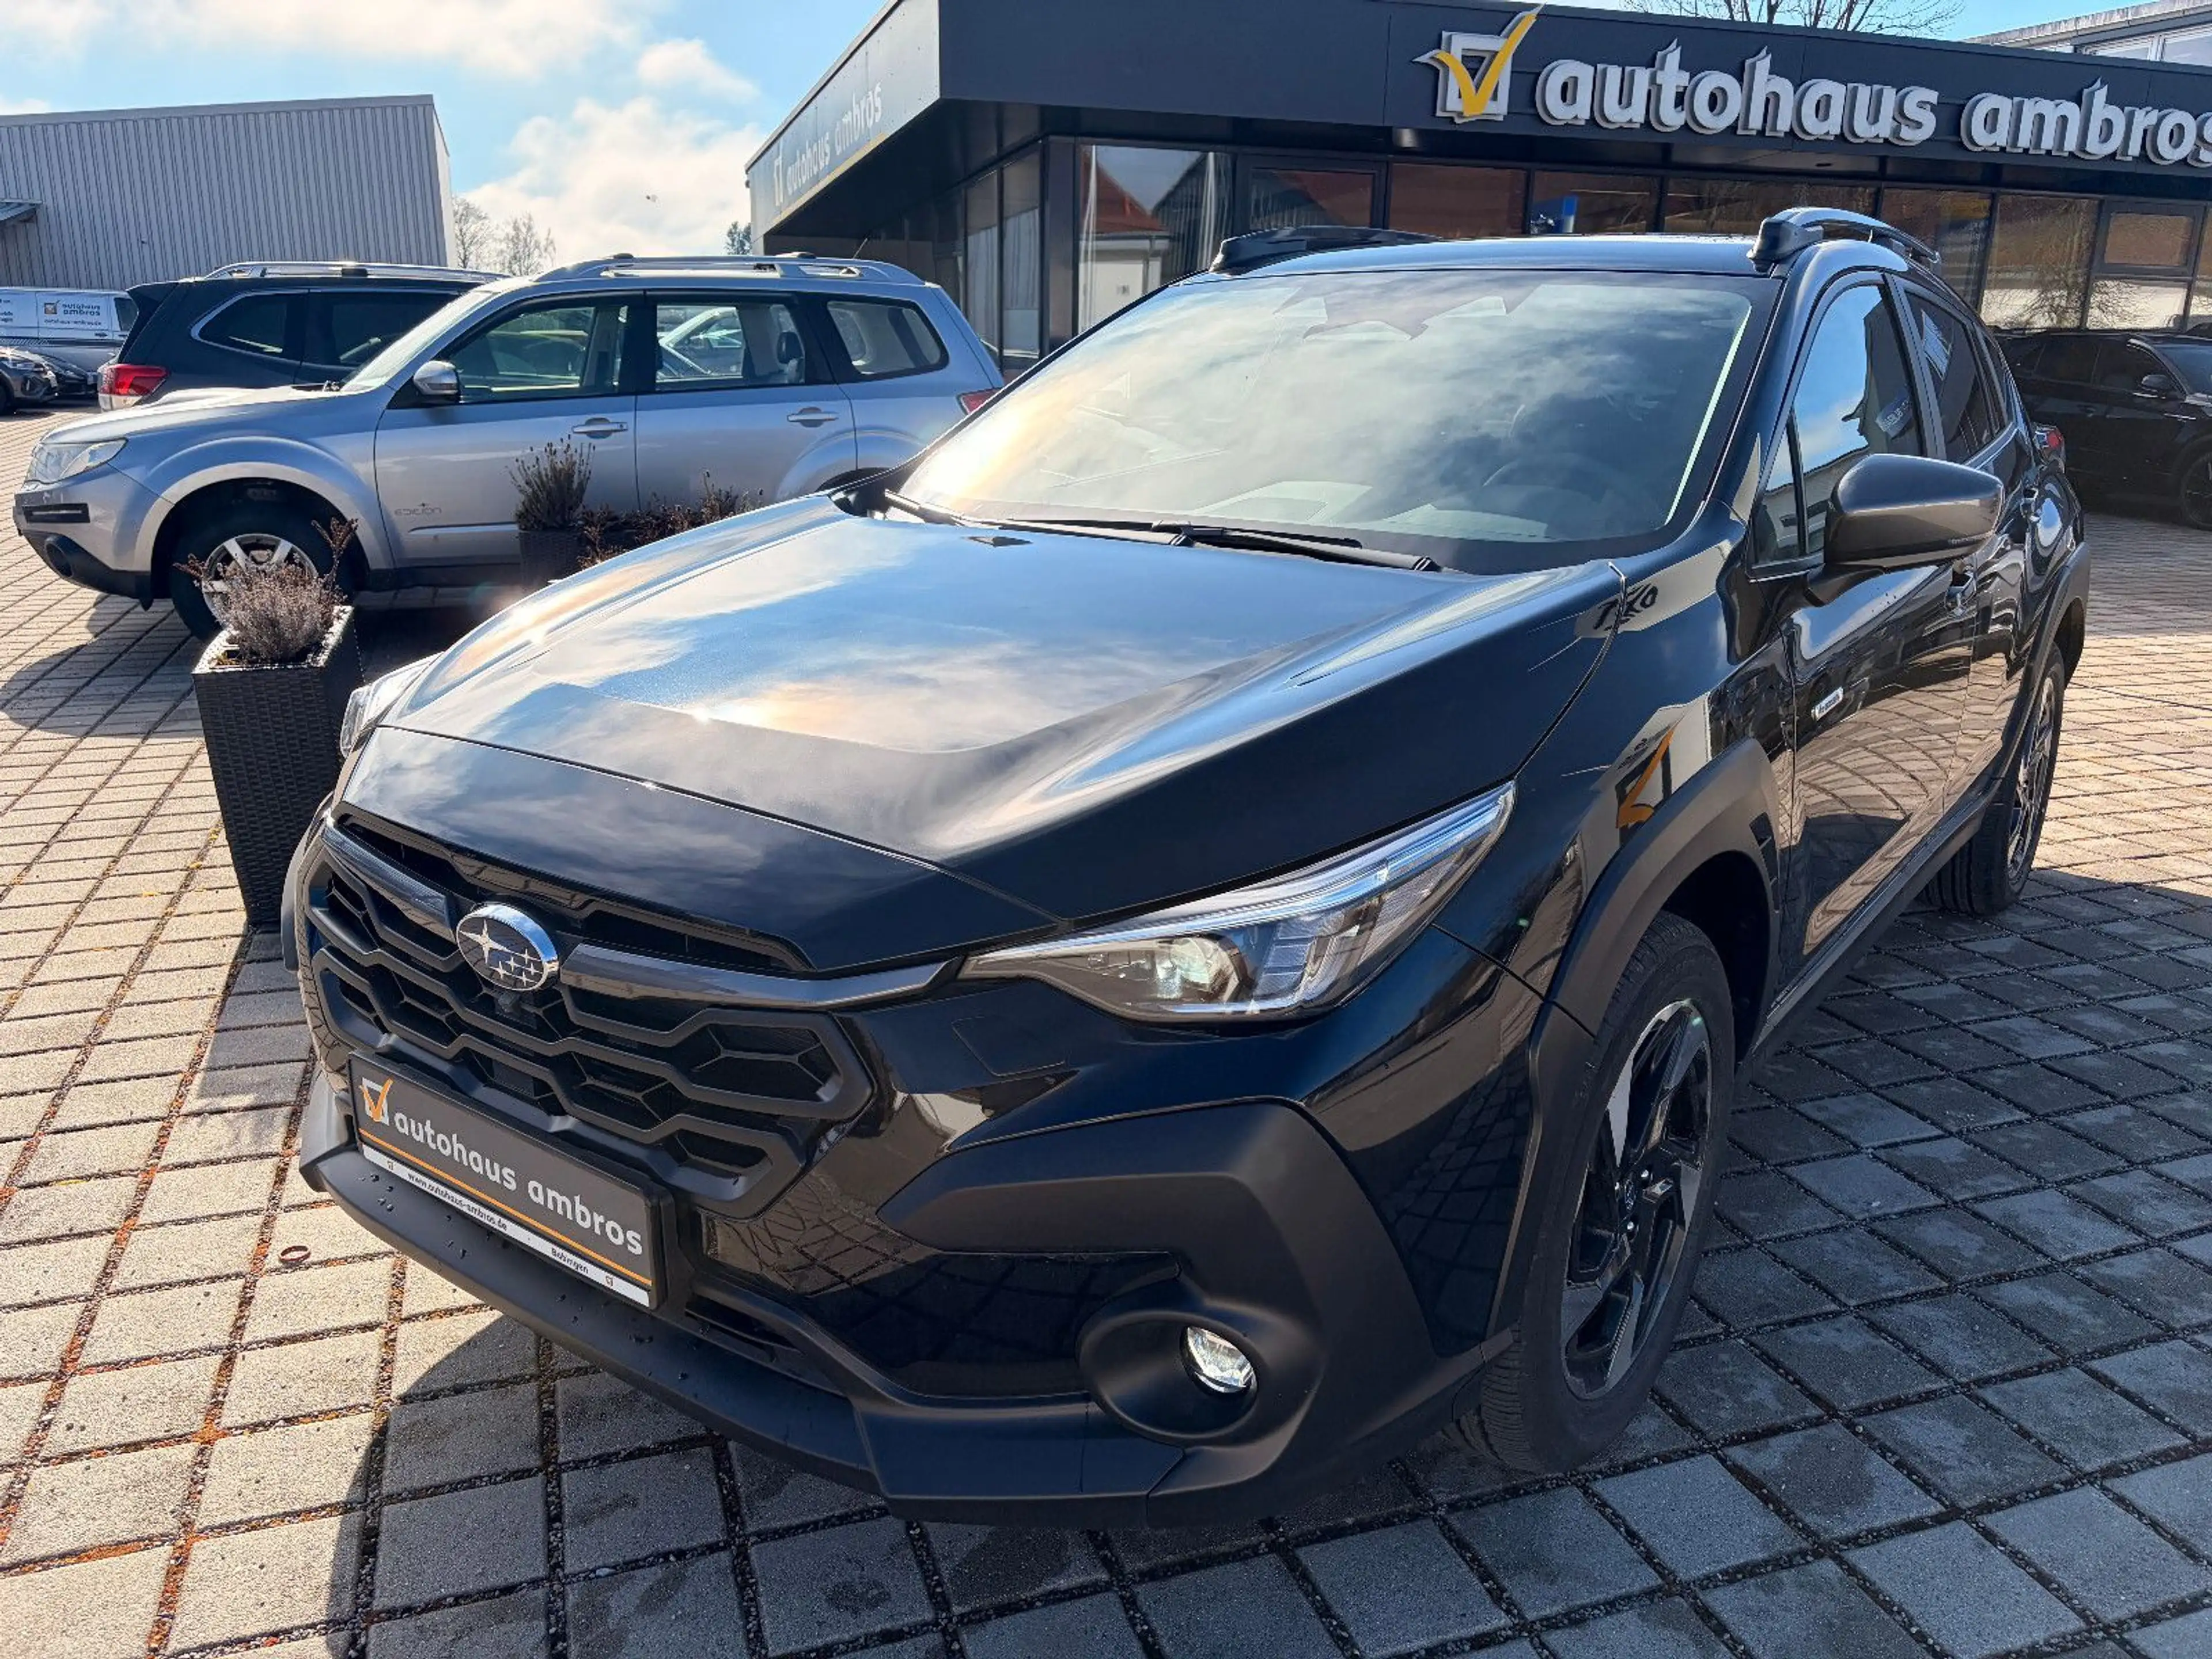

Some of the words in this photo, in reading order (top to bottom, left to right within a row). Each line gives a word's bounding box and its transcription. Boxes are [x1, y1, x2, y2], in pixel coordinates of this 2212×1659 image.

[787, 132, 831, 196] autohaus
[835, 79, 882, 156] ambros
[1536, 38, 1939, 146] autohaus
[394, 1112, 517, 1191] autohaus
[527, 1180, 643, 1256] ambros
